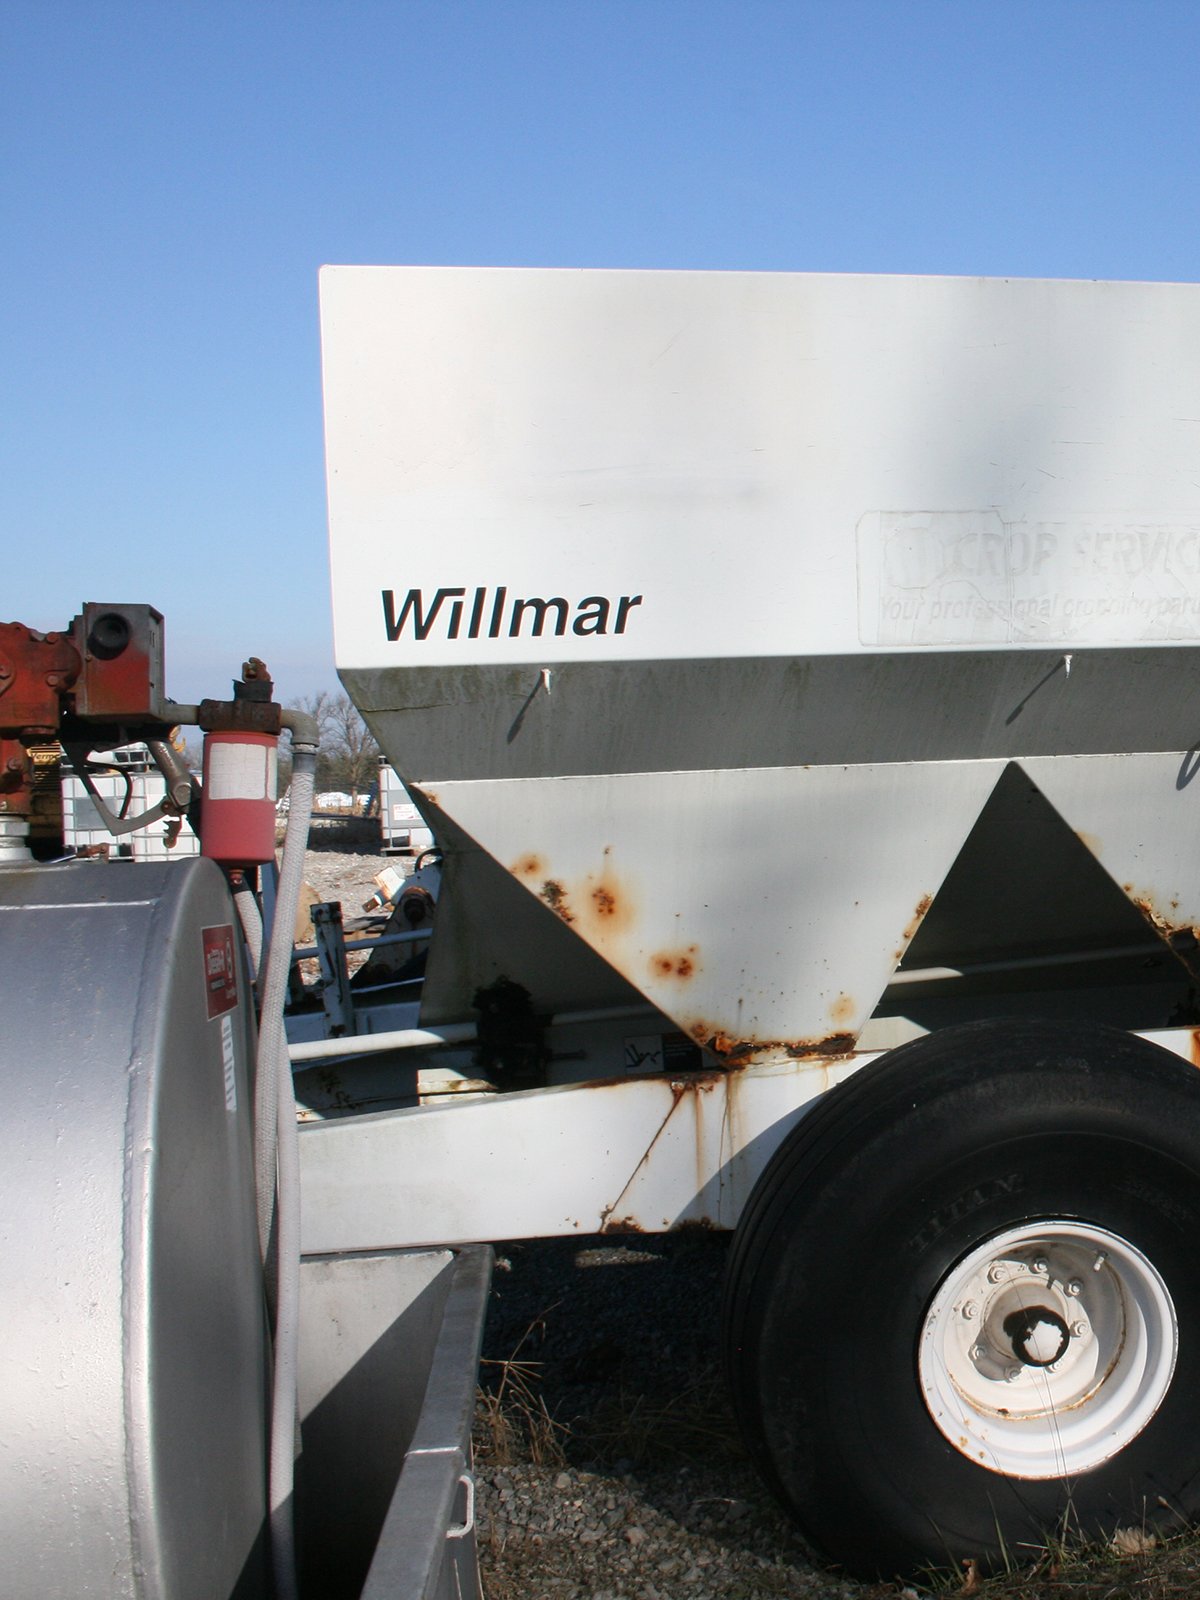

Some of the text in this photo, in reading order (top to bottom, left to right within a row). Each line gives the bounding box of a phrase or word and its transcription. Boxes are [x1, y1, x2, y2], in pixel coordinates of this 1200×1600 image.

[953, 532, 1059, 576] CROP
[381, 586, 643, 642] Willmar
[881, 595, 926, 620] Your
[929, 594, 1058, 625] professonal
